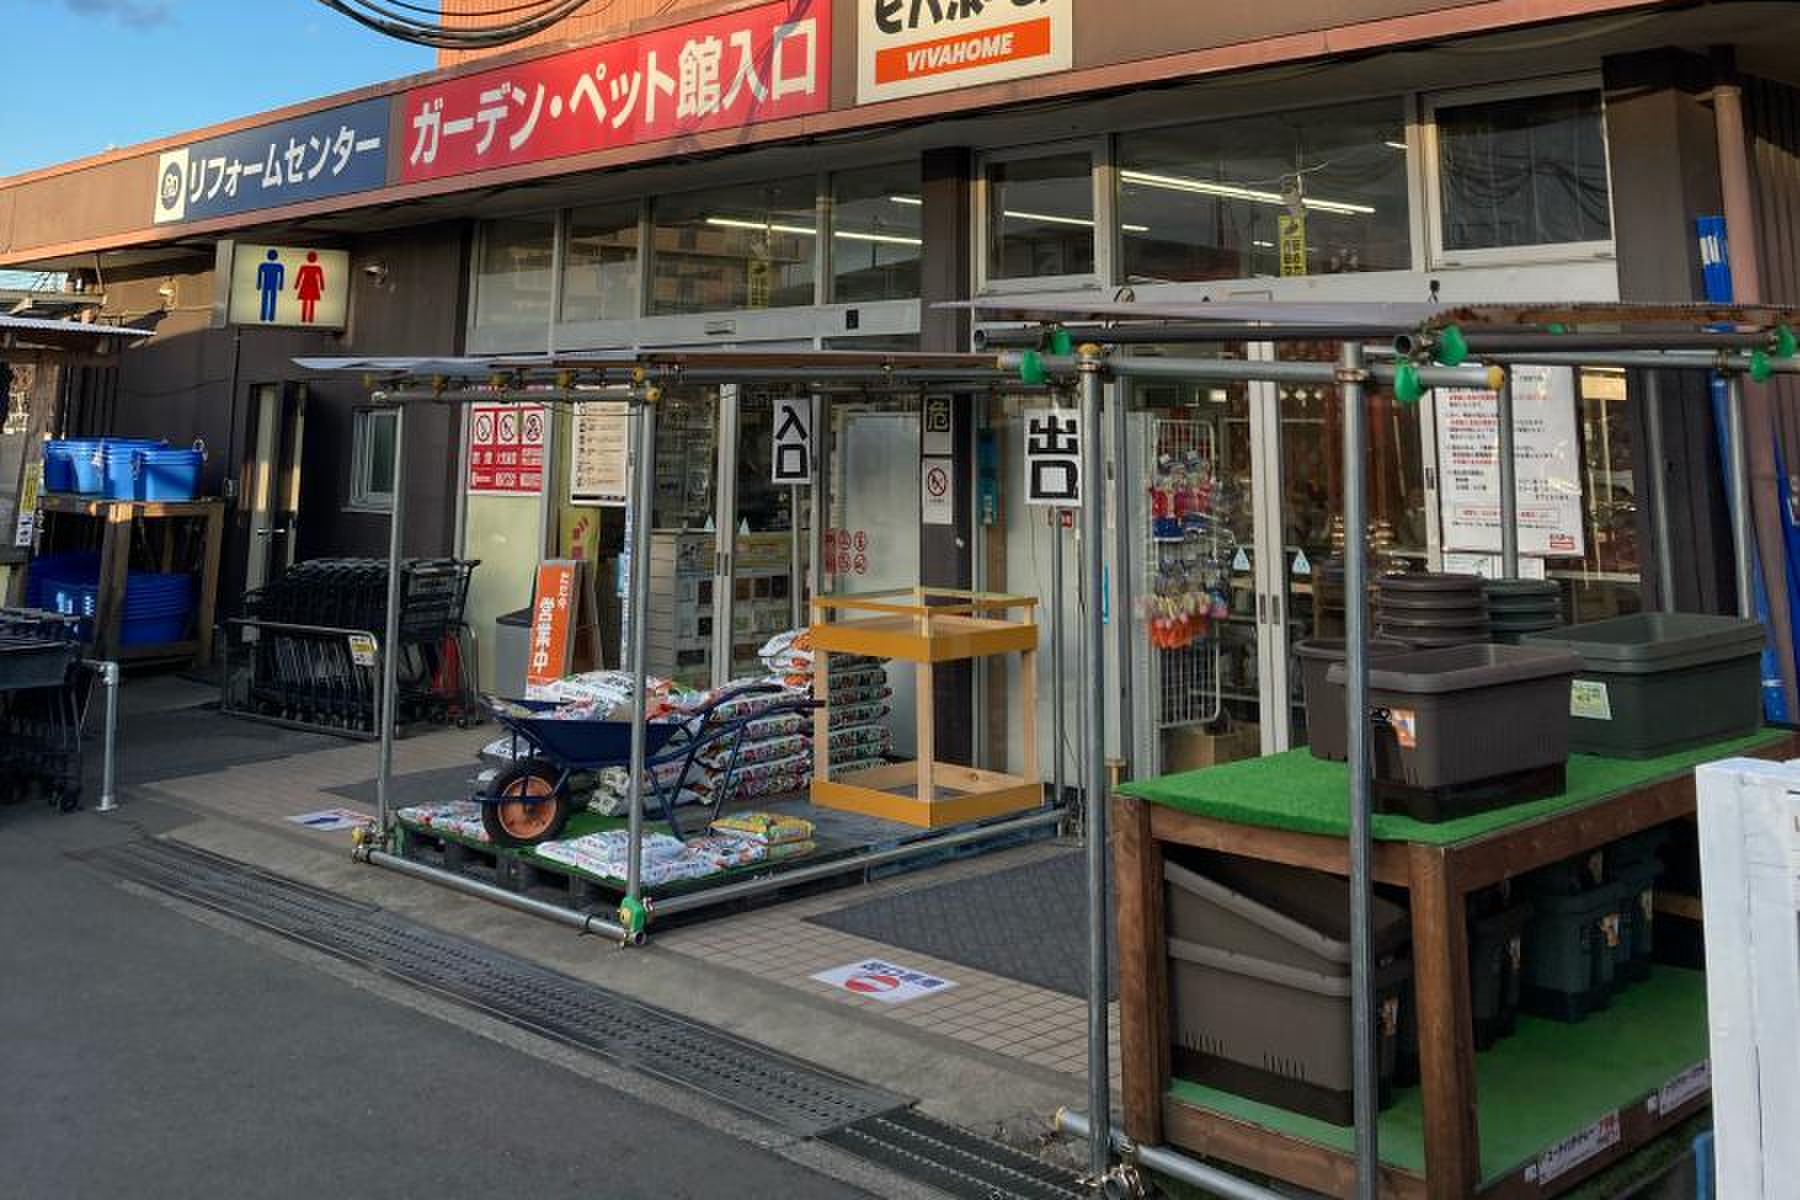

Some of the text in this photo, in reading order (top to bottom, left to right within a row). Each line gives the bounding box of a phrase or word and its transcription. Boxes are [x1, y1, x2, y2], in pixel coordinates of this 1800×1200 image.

[411, 18, 817, 165] ガーデン・ペット館入口
[906, 32, 1015, 73] VIVAHOME
[189, 125, 382, 203] リフォームセンター
[776, 405, 809, 479] 入口
[1028, 416, 1079, 499] 出口
